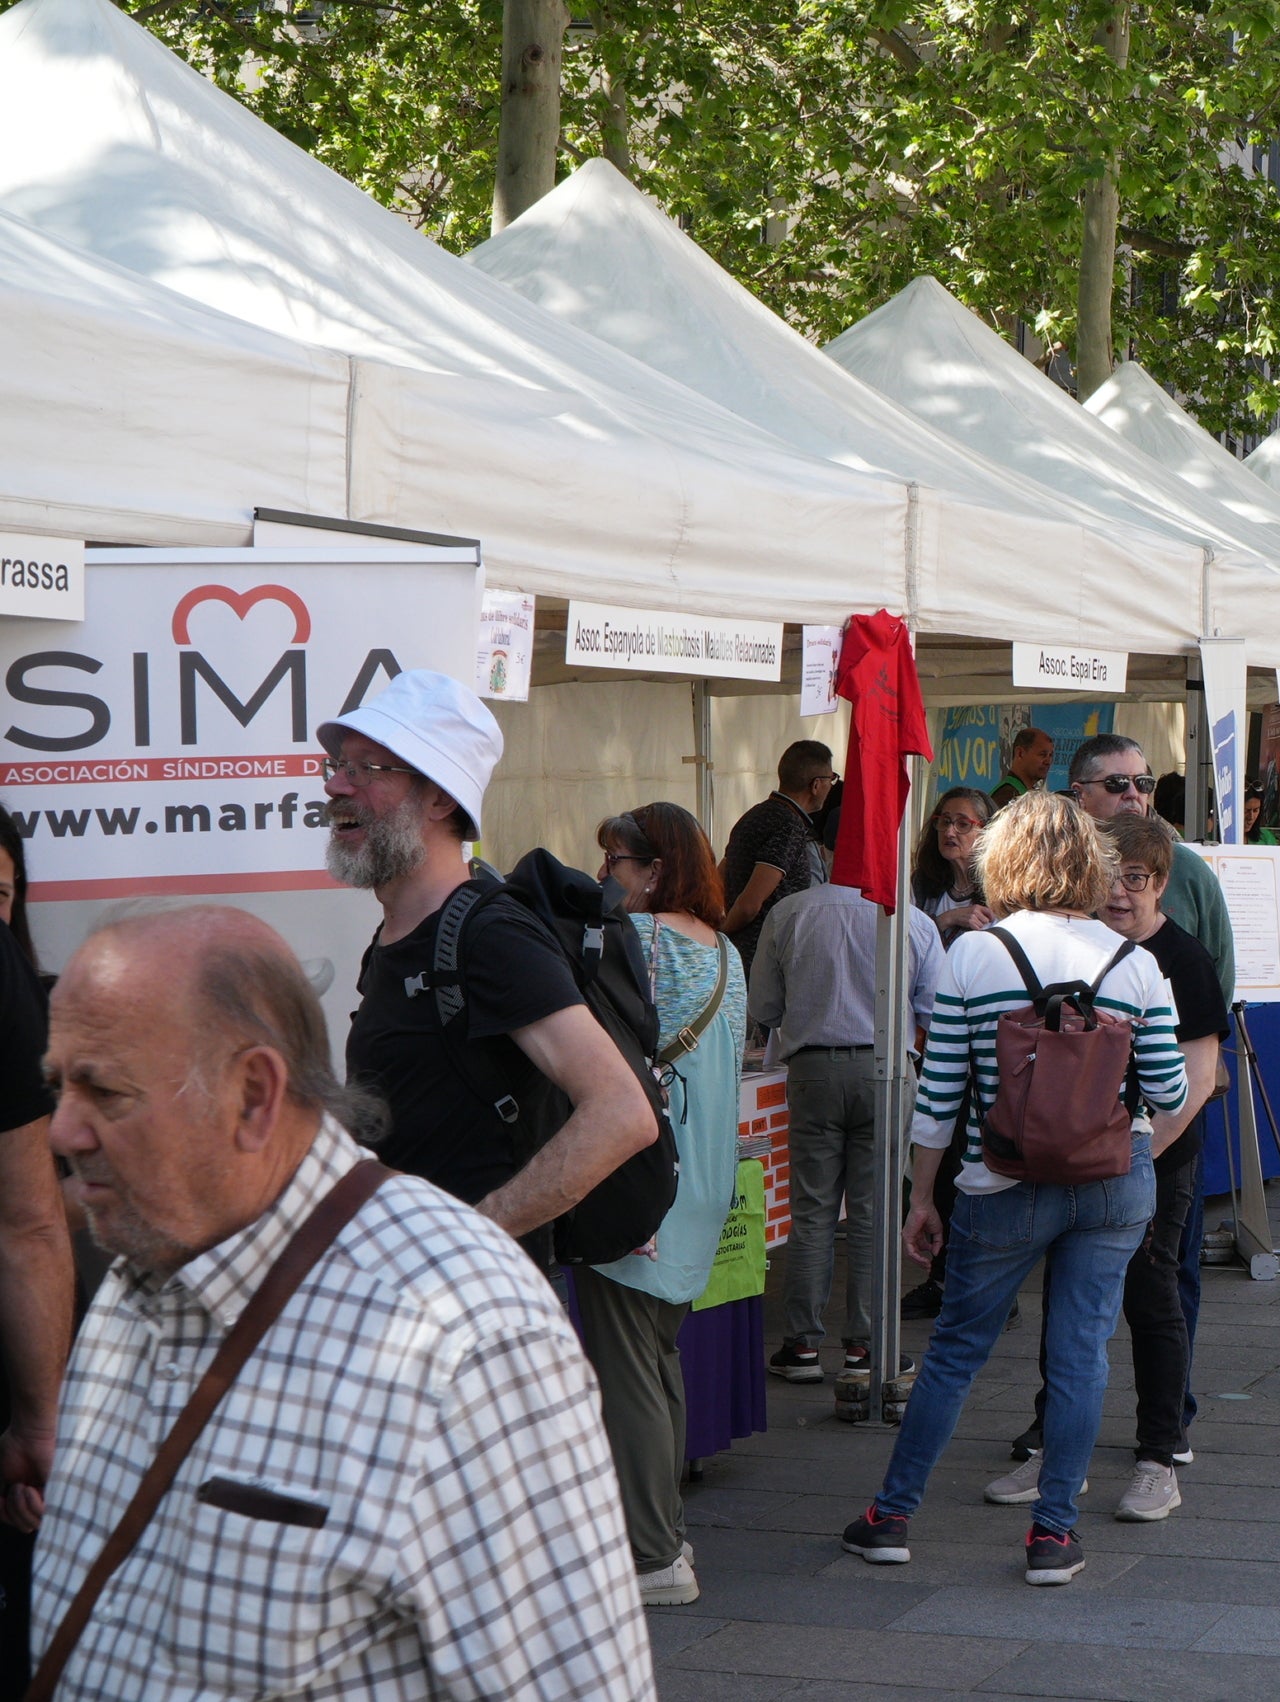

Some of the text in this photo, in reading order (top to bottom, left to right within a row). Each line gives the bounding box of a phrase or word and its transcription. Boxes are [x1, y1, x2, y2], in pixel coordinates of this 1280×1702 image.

[1, 557, 69, 592] rassa
[574, 619, 602, 653] Assoc.
[603, 622, 644, 662] Espanyola
[645, 631, 656, 656] de
[1038, 650, 1108, 684] Assoc. Espai Eira
[4, 760, 148, 783] ASOCIACIÓN
[163, 759, 287, 778] SÍNDROME
